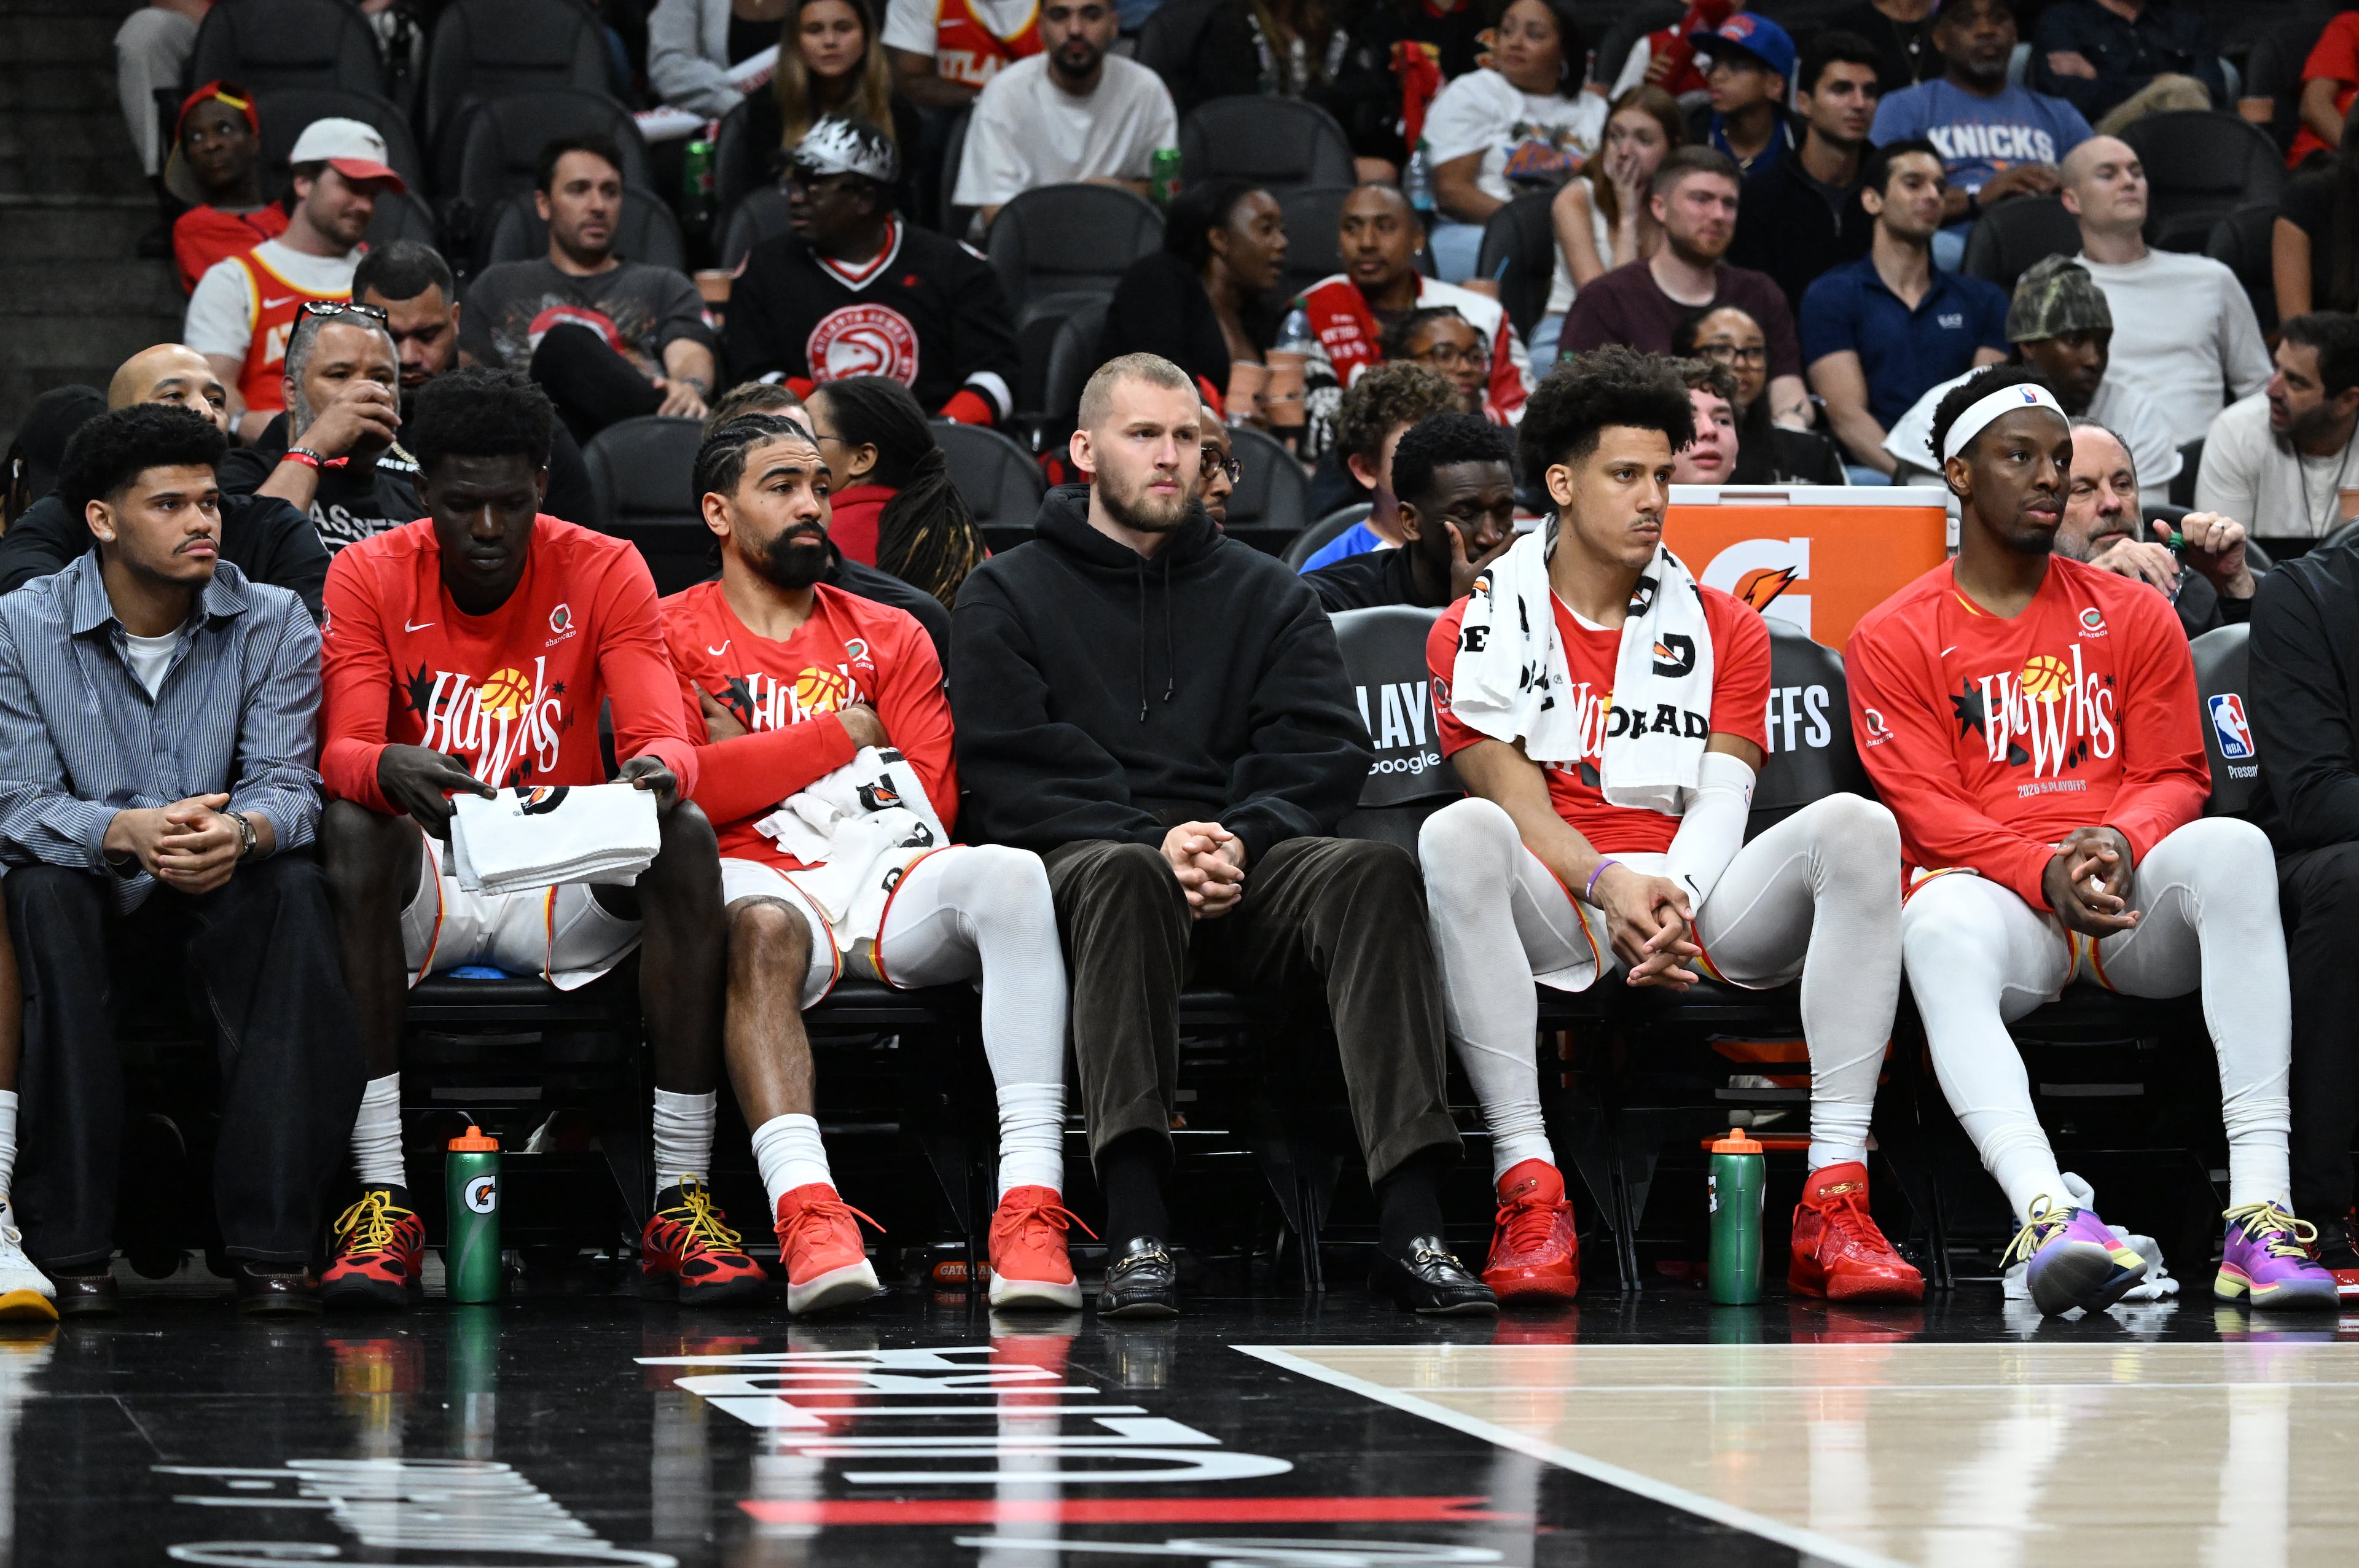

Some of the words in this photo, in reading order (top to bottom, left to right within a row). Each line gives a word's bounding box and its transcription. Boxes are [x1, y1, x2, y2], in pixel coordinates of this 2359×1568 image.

[1927, 124, 2056, 163] KNICKS
[1356, 681, 1439, 750] LAY
[2225, 743, 2242, 755] NBA
[2228, 764, 2258, 780] Presen
[2017, 782, 2040, 799] 2026
[2048, 779, 2087, 793] PLAYOFFS
[464, 1175, 496, 1214] G
